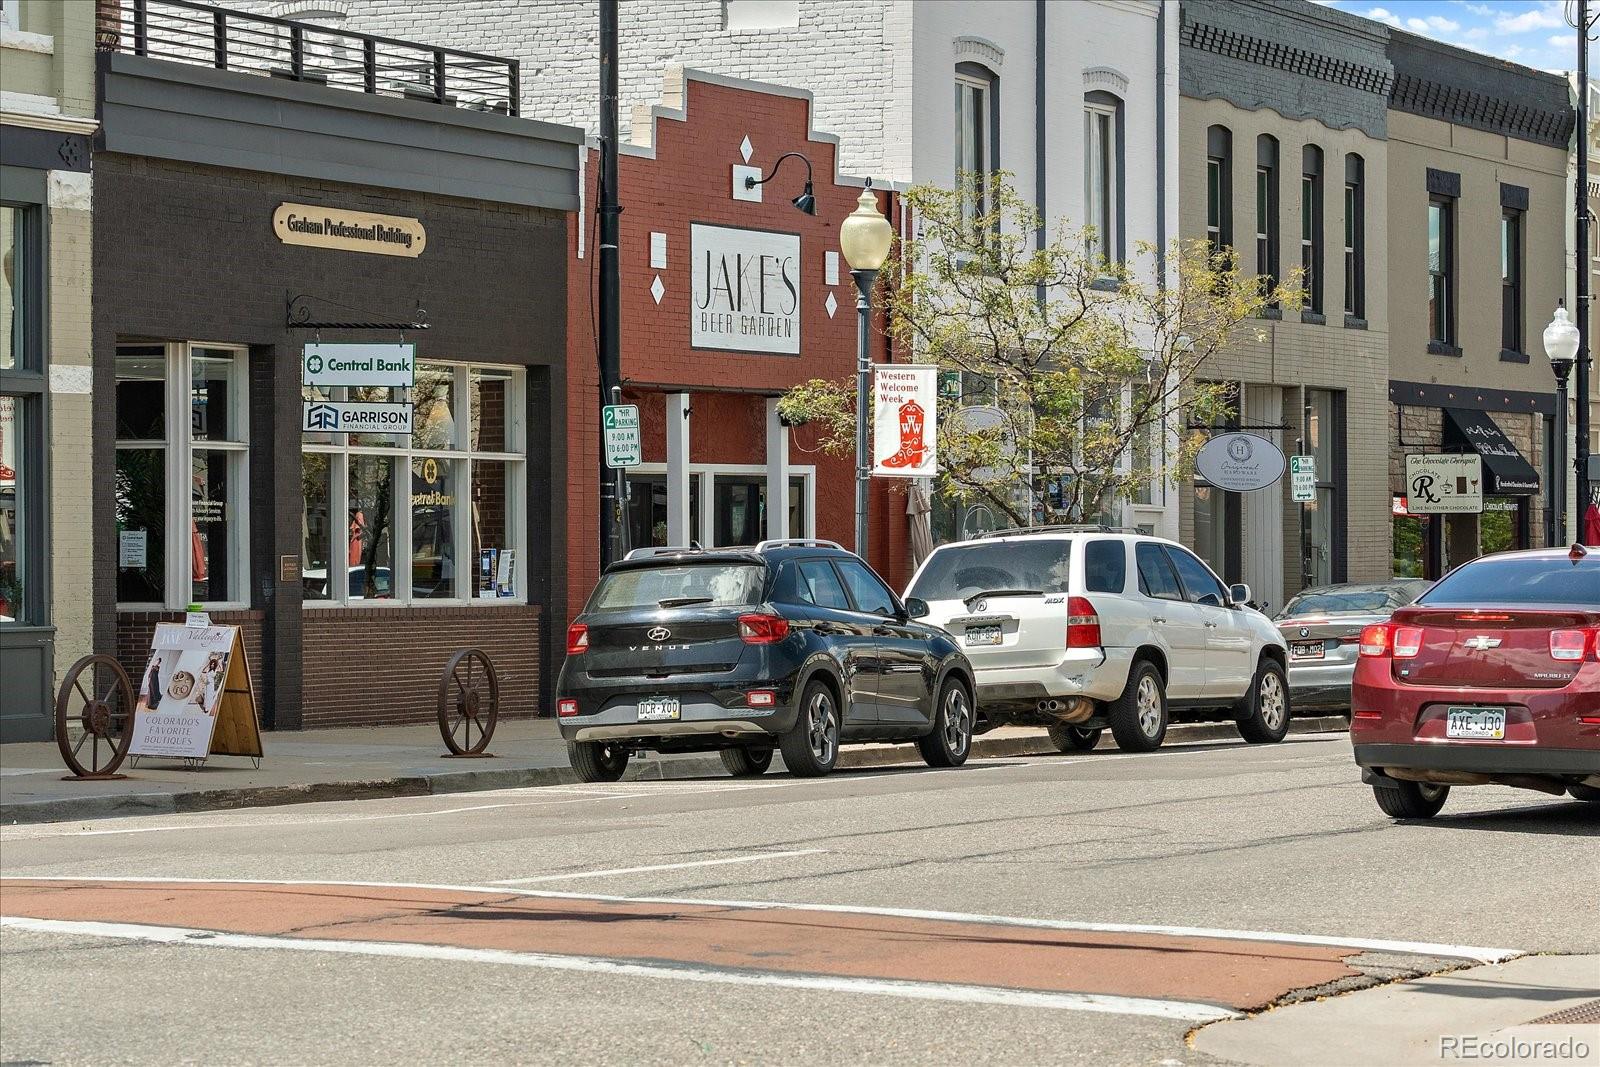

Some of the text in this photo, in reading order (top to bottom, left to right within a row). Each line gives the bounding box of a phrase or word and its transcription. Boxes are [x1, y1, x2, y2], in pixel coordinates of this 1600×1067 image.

[287, 214, 412, 248] Graham Professional Building
[696, 250, 797, 315] JAKE'S
[701, 312, 791, 338] BEER GARDEN
[328, 358, 410, 371] Central Bank
[880, 371, 916, 381] Western
[880, 383, 919, 392] Welcome
[880, 395, 904, 403] Week
[342, 411, 408, 423] GARRISON
[606, 411, 614, 426] 2
[615, 418, 637, 426] PARKING
[627, 433, 635, 441] AM
[1293, 460, 1299, 471] 2
[1423, 457, 1449, 465] Chocolate
[1408, 468, 1440, 480] CHOCOLATE
[145, 716, 200, 727] COLORADO'S
[149, 726, 191, 736] FAVORITE
[144, 736, 192, 745] BOUTIQUES
